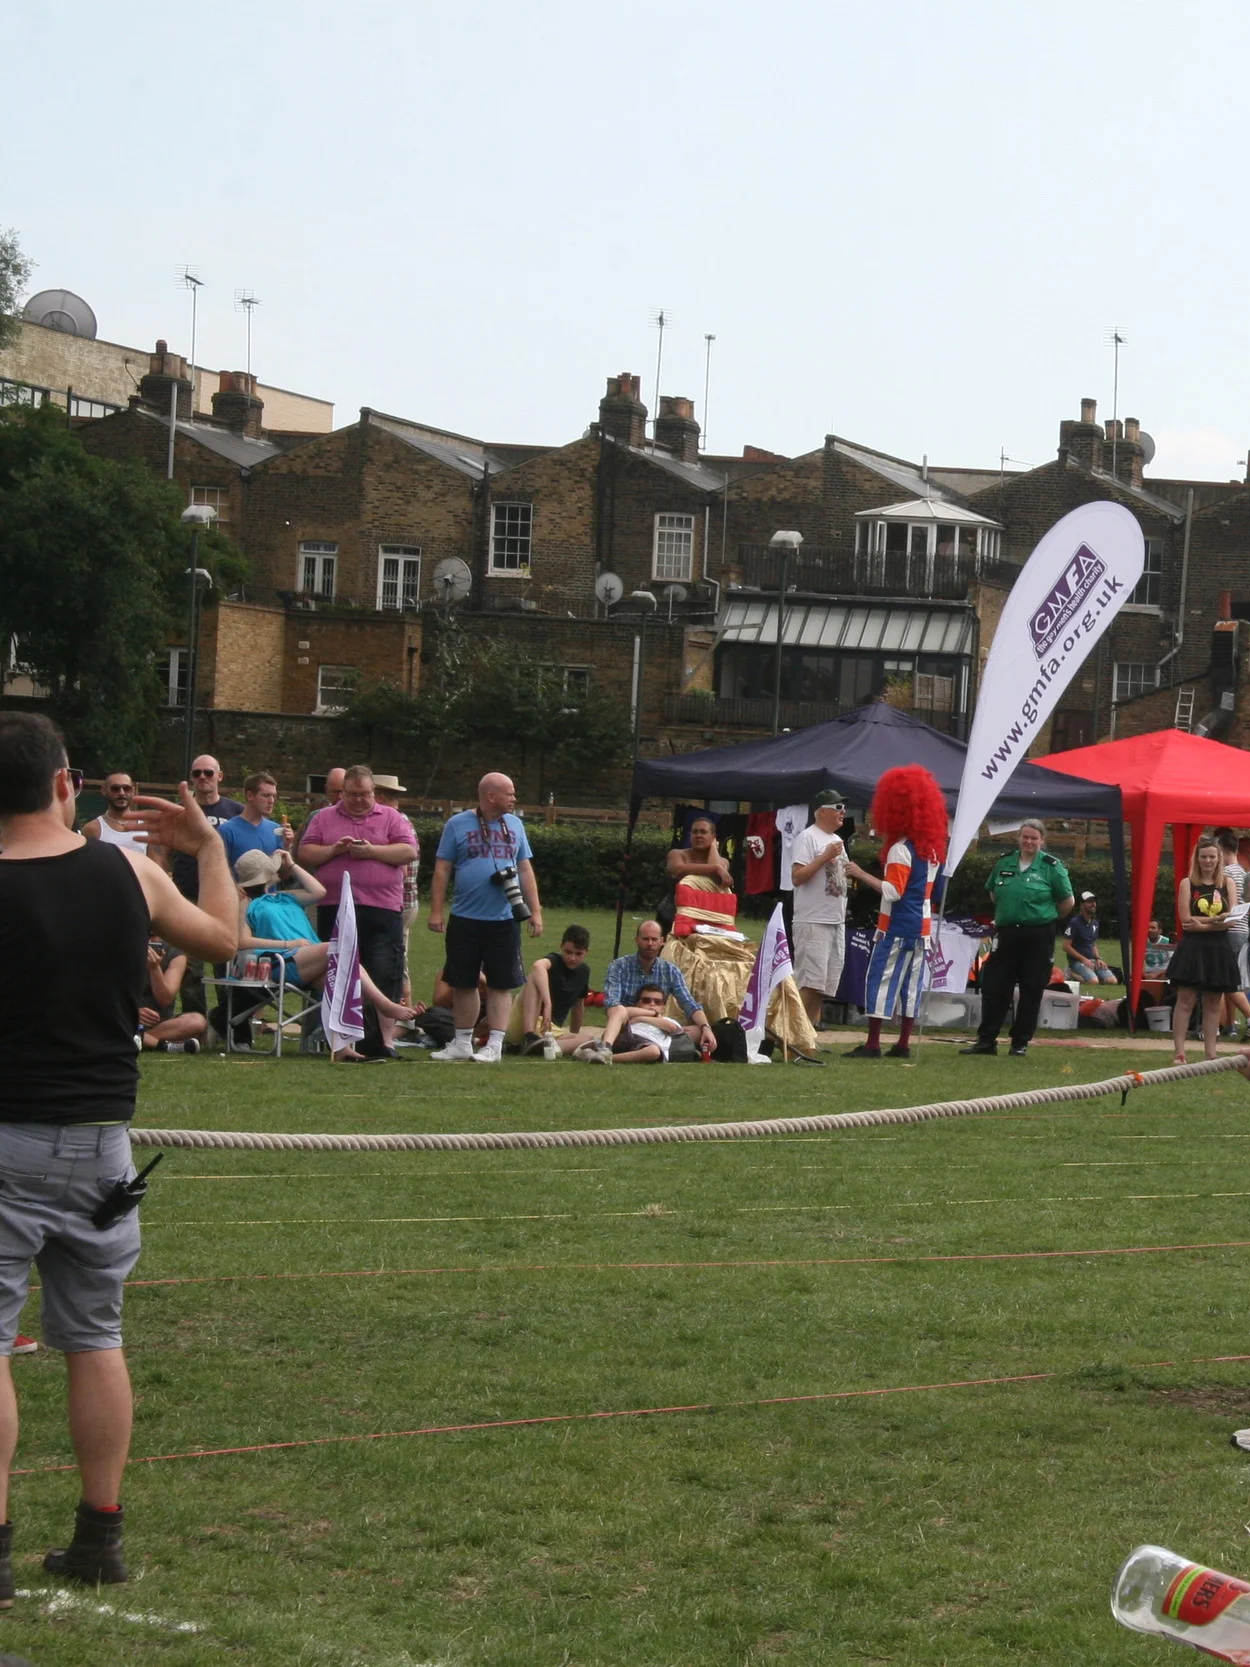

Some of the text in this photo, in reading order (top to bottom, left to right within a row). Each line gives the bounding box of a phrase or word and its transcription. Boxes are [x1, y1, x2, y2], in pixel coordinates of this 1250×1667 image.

[1035, 555, 1097, 634] GMFA
[1036, 642, 1048, 654] the
[1056, 609, 1073, 632] men's
[1067, 586, 1087, 612] health
[1083, 562, 1104, 590] charity
[981, 575, 1125, 780] www.gmfa.org.uk
[466, 829, 517, 845] HNG
[466, 845, 515, 860] OVER
